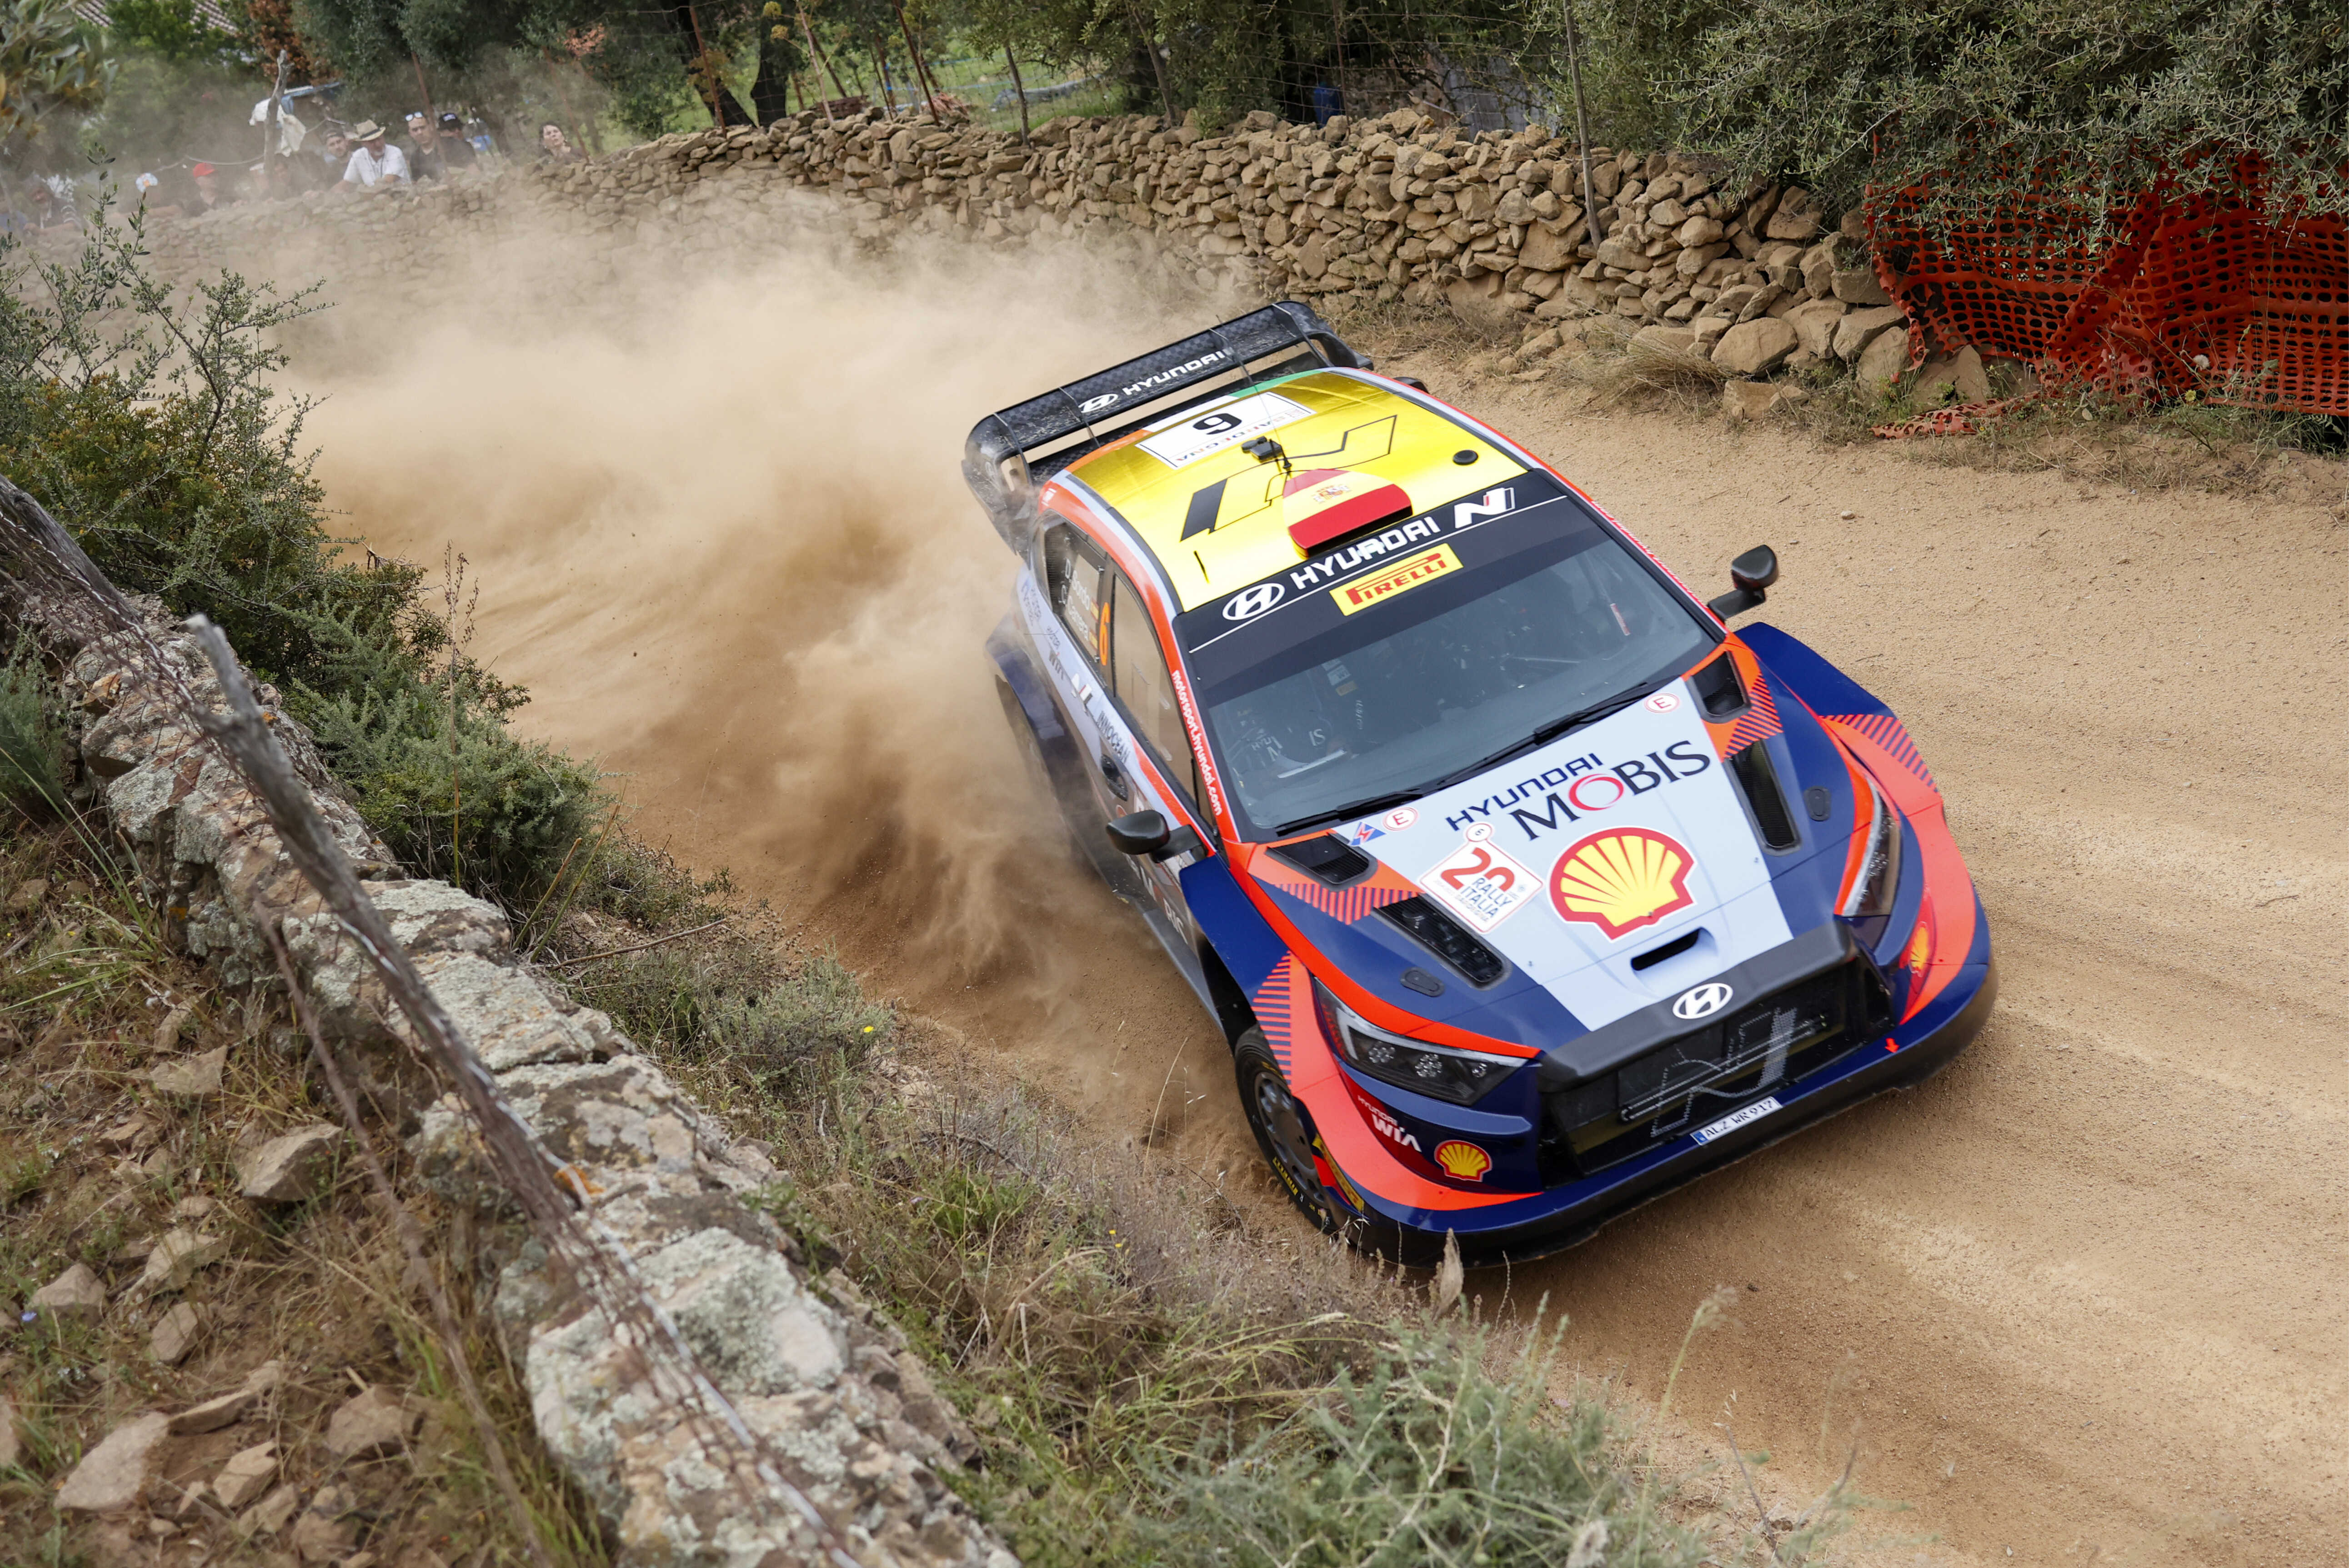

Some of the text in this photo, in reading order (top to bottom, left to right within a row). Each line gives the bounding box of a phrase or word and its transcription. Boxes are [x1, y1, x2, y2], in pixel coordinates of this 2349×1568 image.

[1122, 350, 1226, 395] HYUNDAI
[1290, 516, 1441, 590] HYUNDAI
[1345, 553, 1447, 605] PIRELLI
[1099, 602, 1111, 666] 6
[1653, 695, 1671, 710] E
[1172, 669, 1222, 816] motorsport.hyundai.com
[1445, 753, 1605, 831] HYUNDAI
[1508, 740, 1711, 841] MOBIS
[1393, 811, 1409, 825] E
[1460, 886, 1499, 918] ITALIA
[1472, 877, 1513, 907] RALLY
[1357, 1094, 1398, 1126] HYUNDAI
[1730, 1112, 1751, 1124] WR
[1749, 1100, 1773, 1116] 917
[1371, 1113, 1422, 1153] WIA
